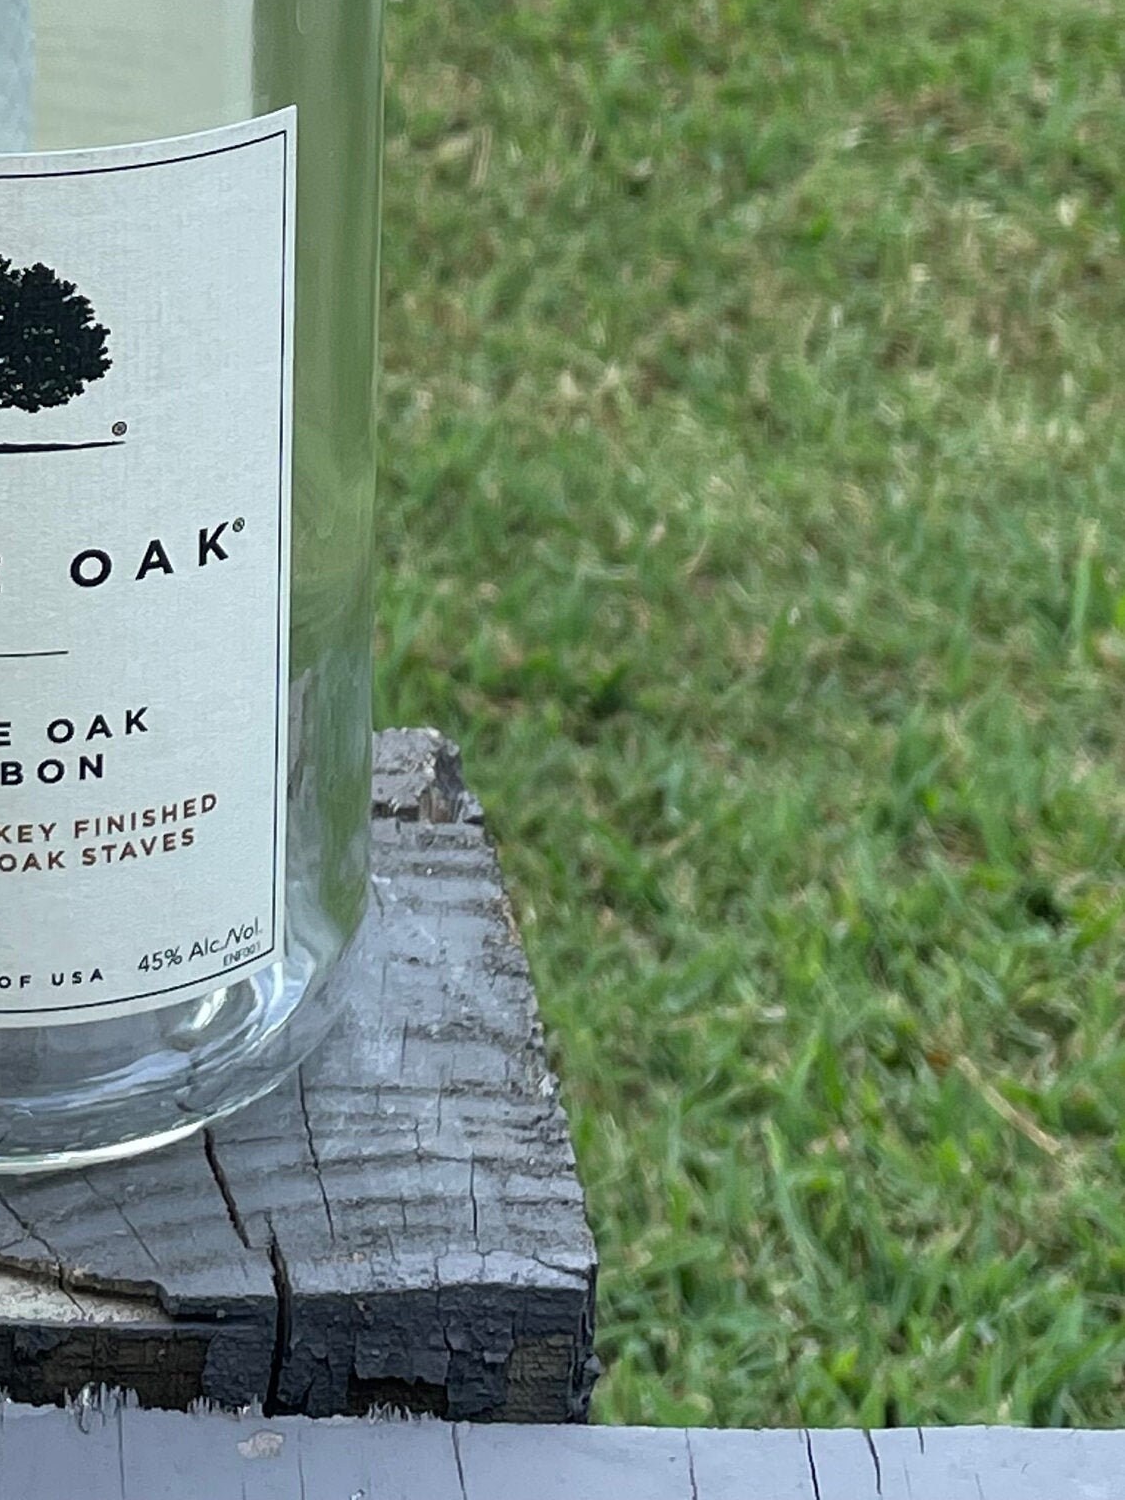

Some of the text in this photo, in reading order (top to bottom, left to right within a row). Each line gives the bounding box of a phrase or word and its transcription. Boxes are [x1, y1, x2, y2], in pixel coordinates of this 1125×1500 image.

[47, 707, 148, 744] OAK
[74, 794, 216, 839] FINISHED
[82, 828, 194, 866] STAVES
[51, 968, 103, 986] USA
[138, 945, 183, 973] 45%
